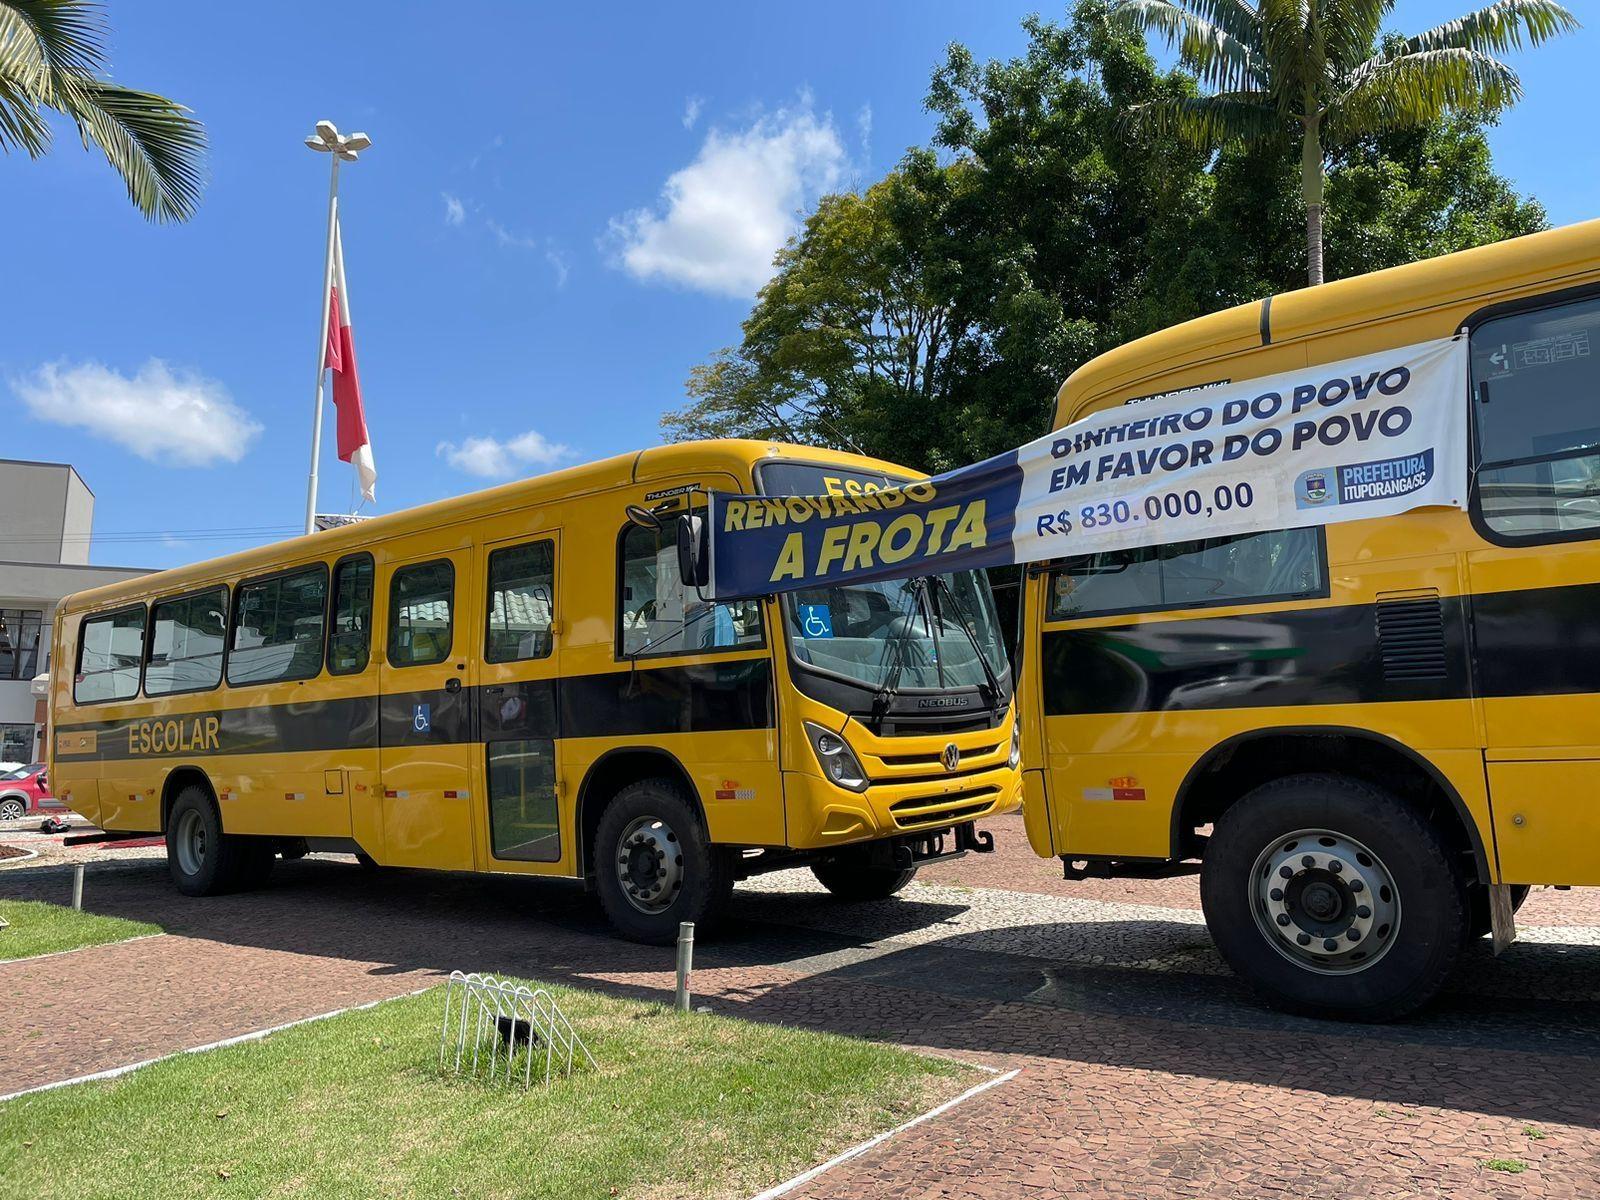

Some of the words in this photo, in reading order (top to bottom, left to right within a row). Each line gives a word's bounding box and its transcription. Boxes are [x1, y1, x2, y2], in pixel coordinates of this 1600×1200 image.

[1050, 407, 1213, 459] DINHEIRO
[1222, 392, 1282, 426] DO
[1291, 366, 1411, 414] POVO
[1048, 460, 1091, 494] EM
[1096, 439, 1214, 482] FAVOR
[1222, 428, 1282, 462] DO
[1292, 406, 1412, 451] POVO
[1343, 455, 1426, 485] PREFEITURA
[724, 481, 937, 532] RENOVANDO
[1036, 509, 1073, 536] R$
[1080, 482, 1254, 528] 830.000,00
[1343, 471, 1426, 501] ITUPORANGA/SC
[769, 531, 804, 582] A
[815, 499, 988, 576] FROTA
[919, 697, 968, 708] NEOBUS
[128, 716, 220, 754] ESCOLAR
